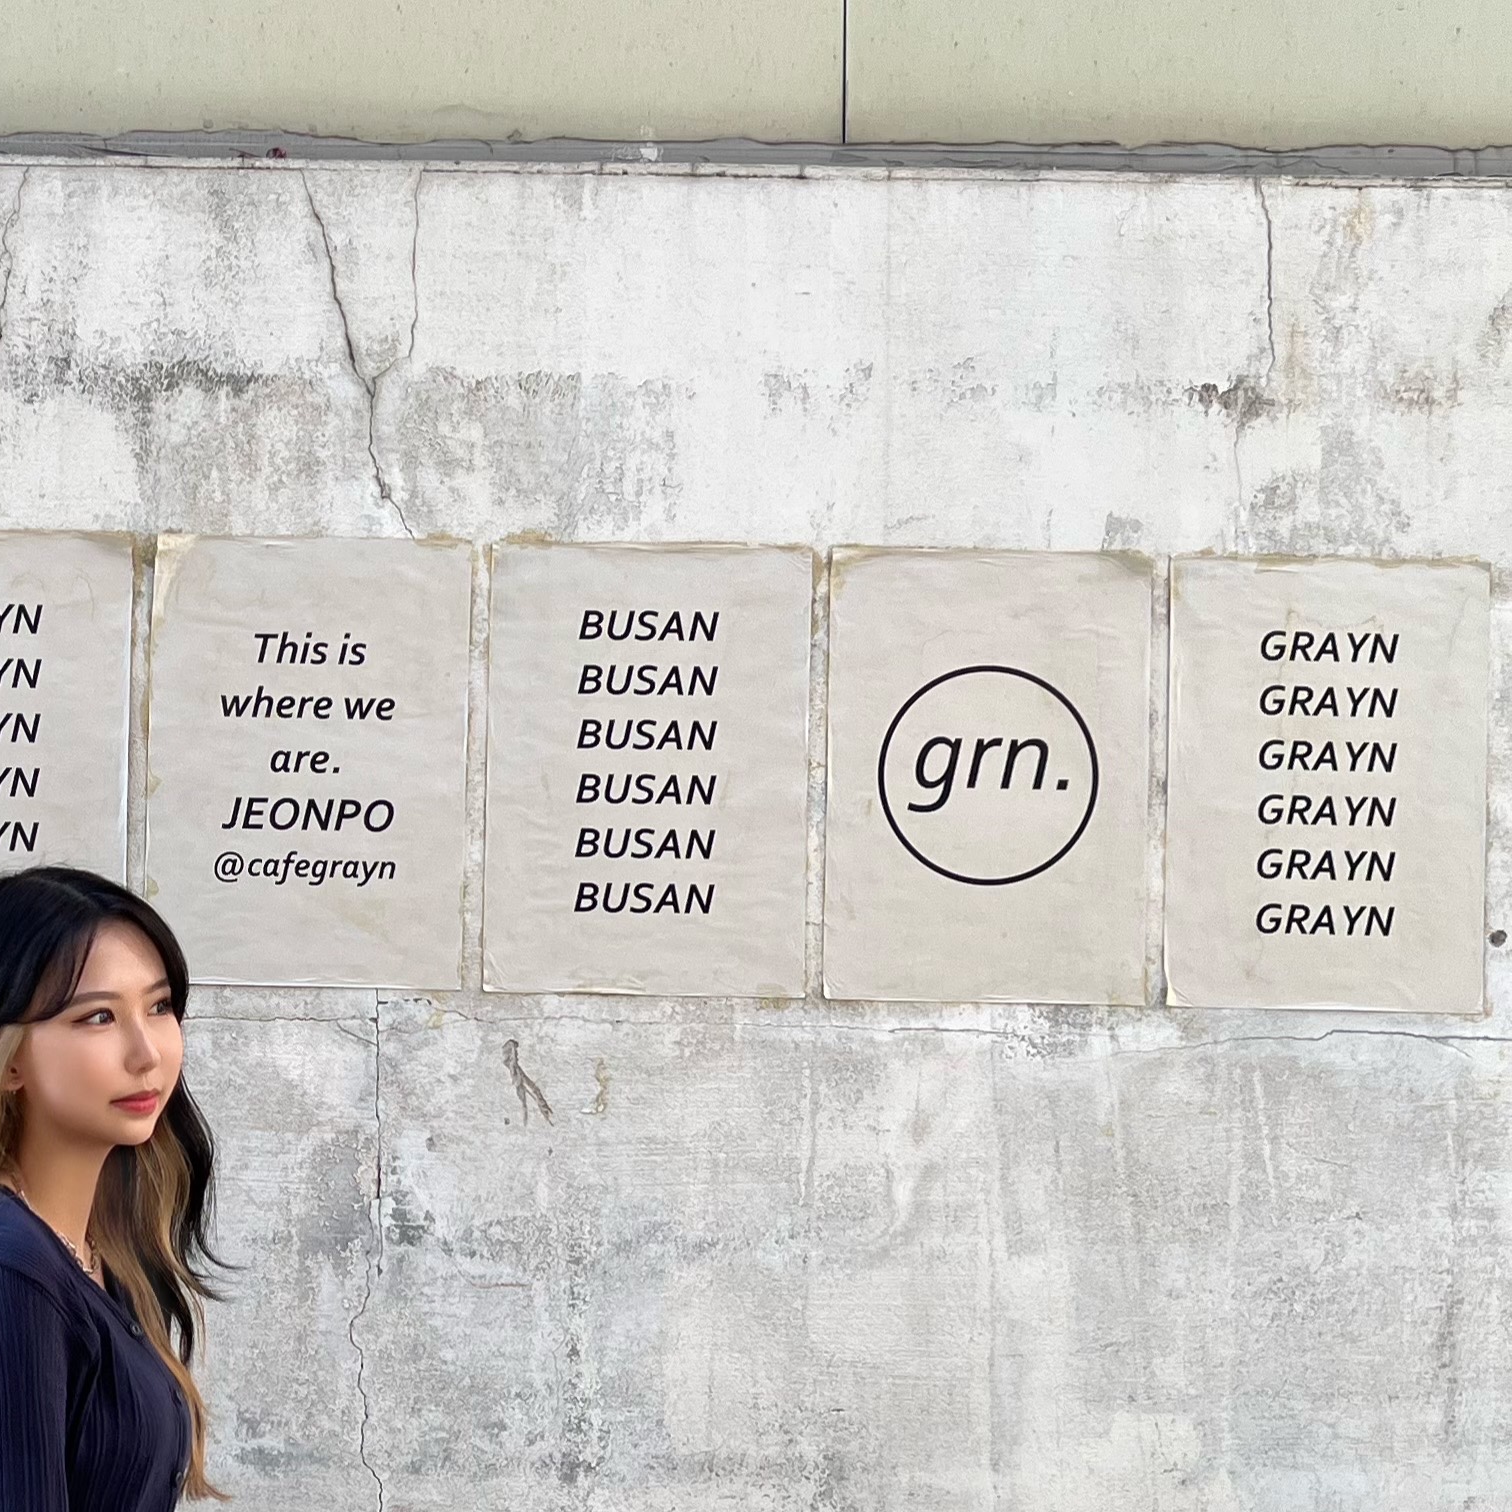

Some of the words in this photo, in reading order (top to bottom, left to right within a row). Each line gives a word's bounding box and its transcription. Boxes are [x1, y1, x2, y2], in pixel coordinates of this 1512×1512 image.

[578, 609, 720, 642] BUSAN
[254, 631, 329, 665] This
[337, 632, 367, 666] is
[1260, 630, 1400, 664] GRAYN
[577, 664, 719, 696] BUSAN
[220, 685, 333, 720] where
[344, 697, 396, 721] we
[1259, 684, 1399, 718] GRAYN
[576, 719, 718, 751] BUSAN
[270, 750, 340, 774] are.
[1258, 739, 1398, 773] GRAYN
[575, 773, 717, 806] BUSAN
[907, 736, 1069, 813] grn.
[221, 796, 395, 833] JEONPO
[1258, 794, 1397, 827] GRAYN
[574, 827, 716, 860] BUSAN
[214, 850, 396, 887] @cafegrayn
[1257, 848, 1396, 882] GRAYN
[573, 882, 715, 914] BUSAN
[1255, 903, 1395, 937] GRAYN
